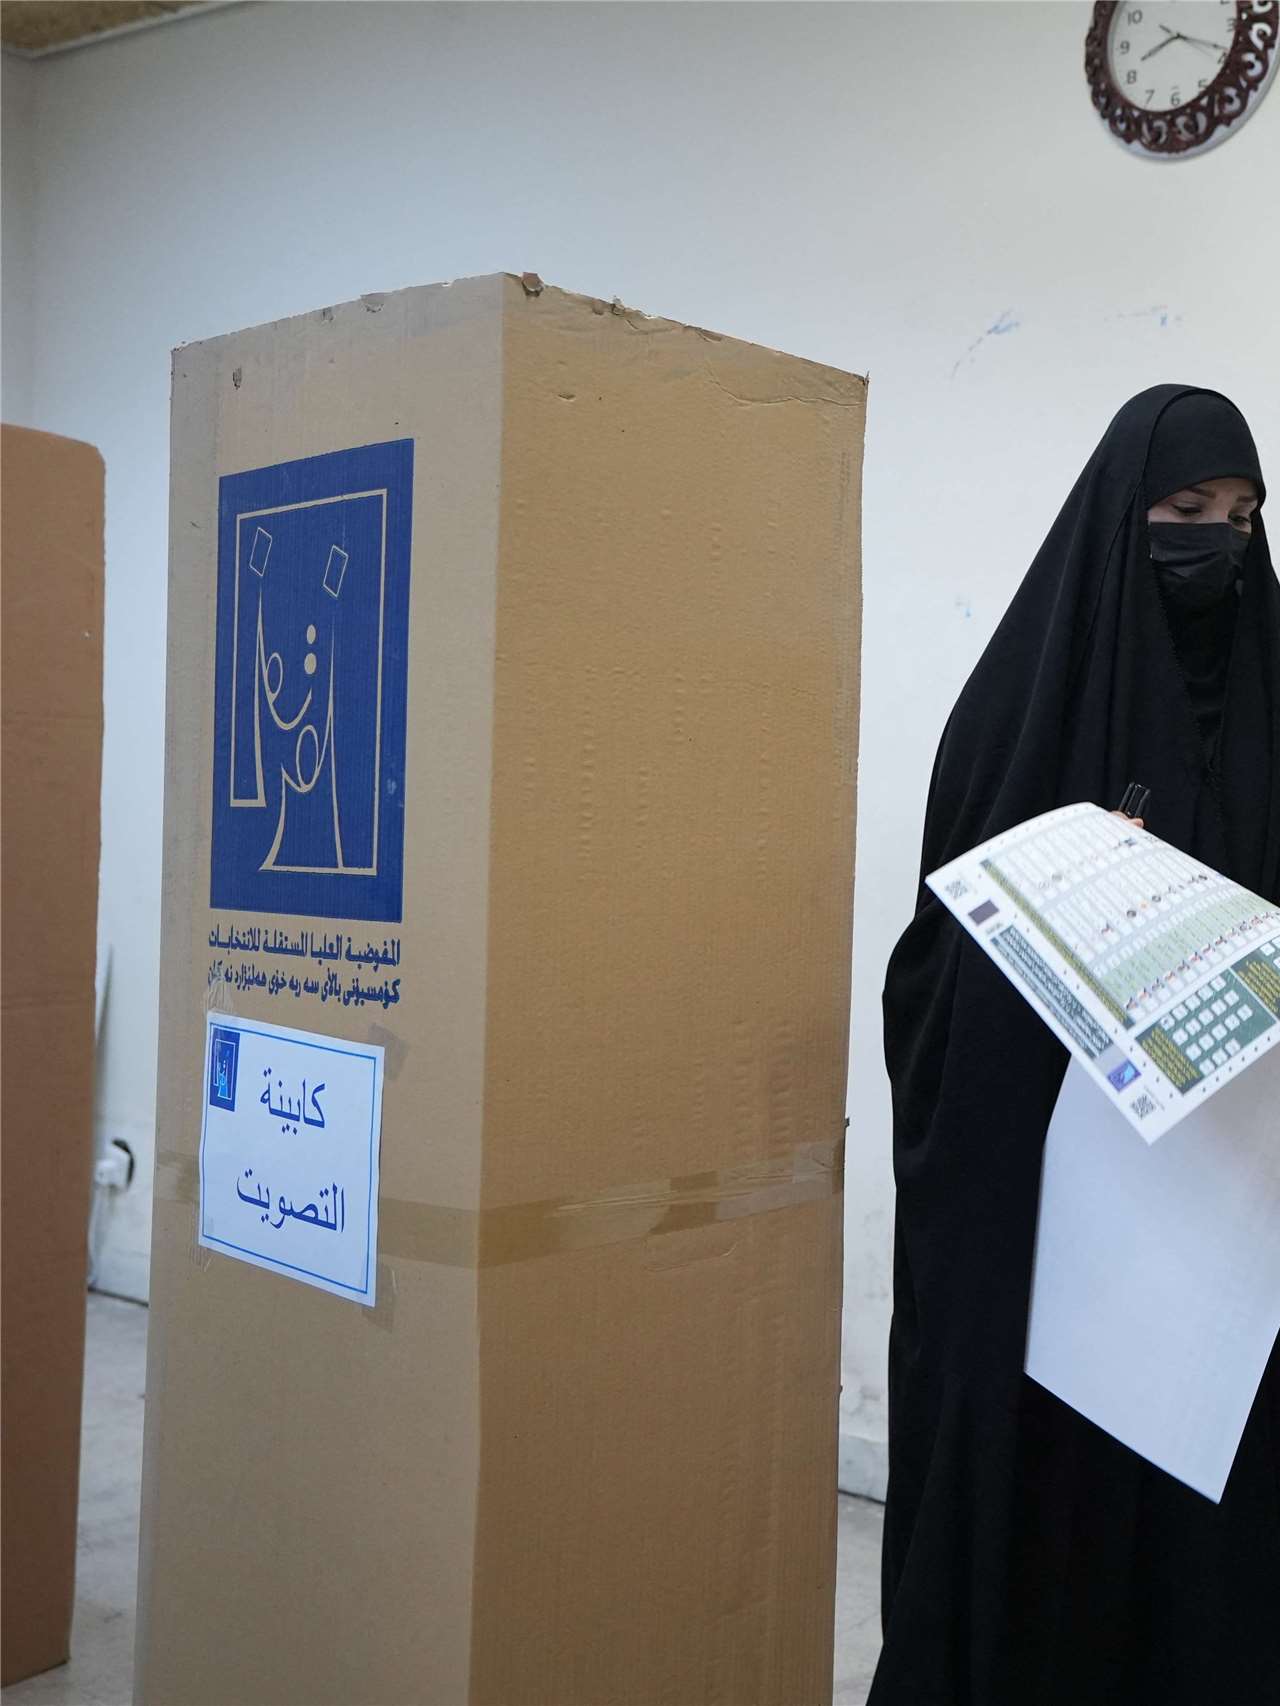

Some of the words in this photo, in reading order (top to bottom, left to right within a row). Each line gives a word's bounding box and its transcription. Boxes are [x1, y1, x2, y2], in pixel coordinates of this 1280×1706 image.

[1126, 9, 1143, 26] 10
[1119, 40, 1130, 55] 9
[1126, 69, 1137, 84] 8
[1145, 89, 1155, 105] 7
[1170, 91, 1181, 107] 6
[208, 923, 260, 955] للانتخابات
[263, 928, 308, 957] المستقلة
[311, 931, 343, 966] العليا
[345, 937, 400, 973] المفوضية
[260, 1067, 326, 1135] كابينة
[237, 1168, 345, 1233] التصويت
